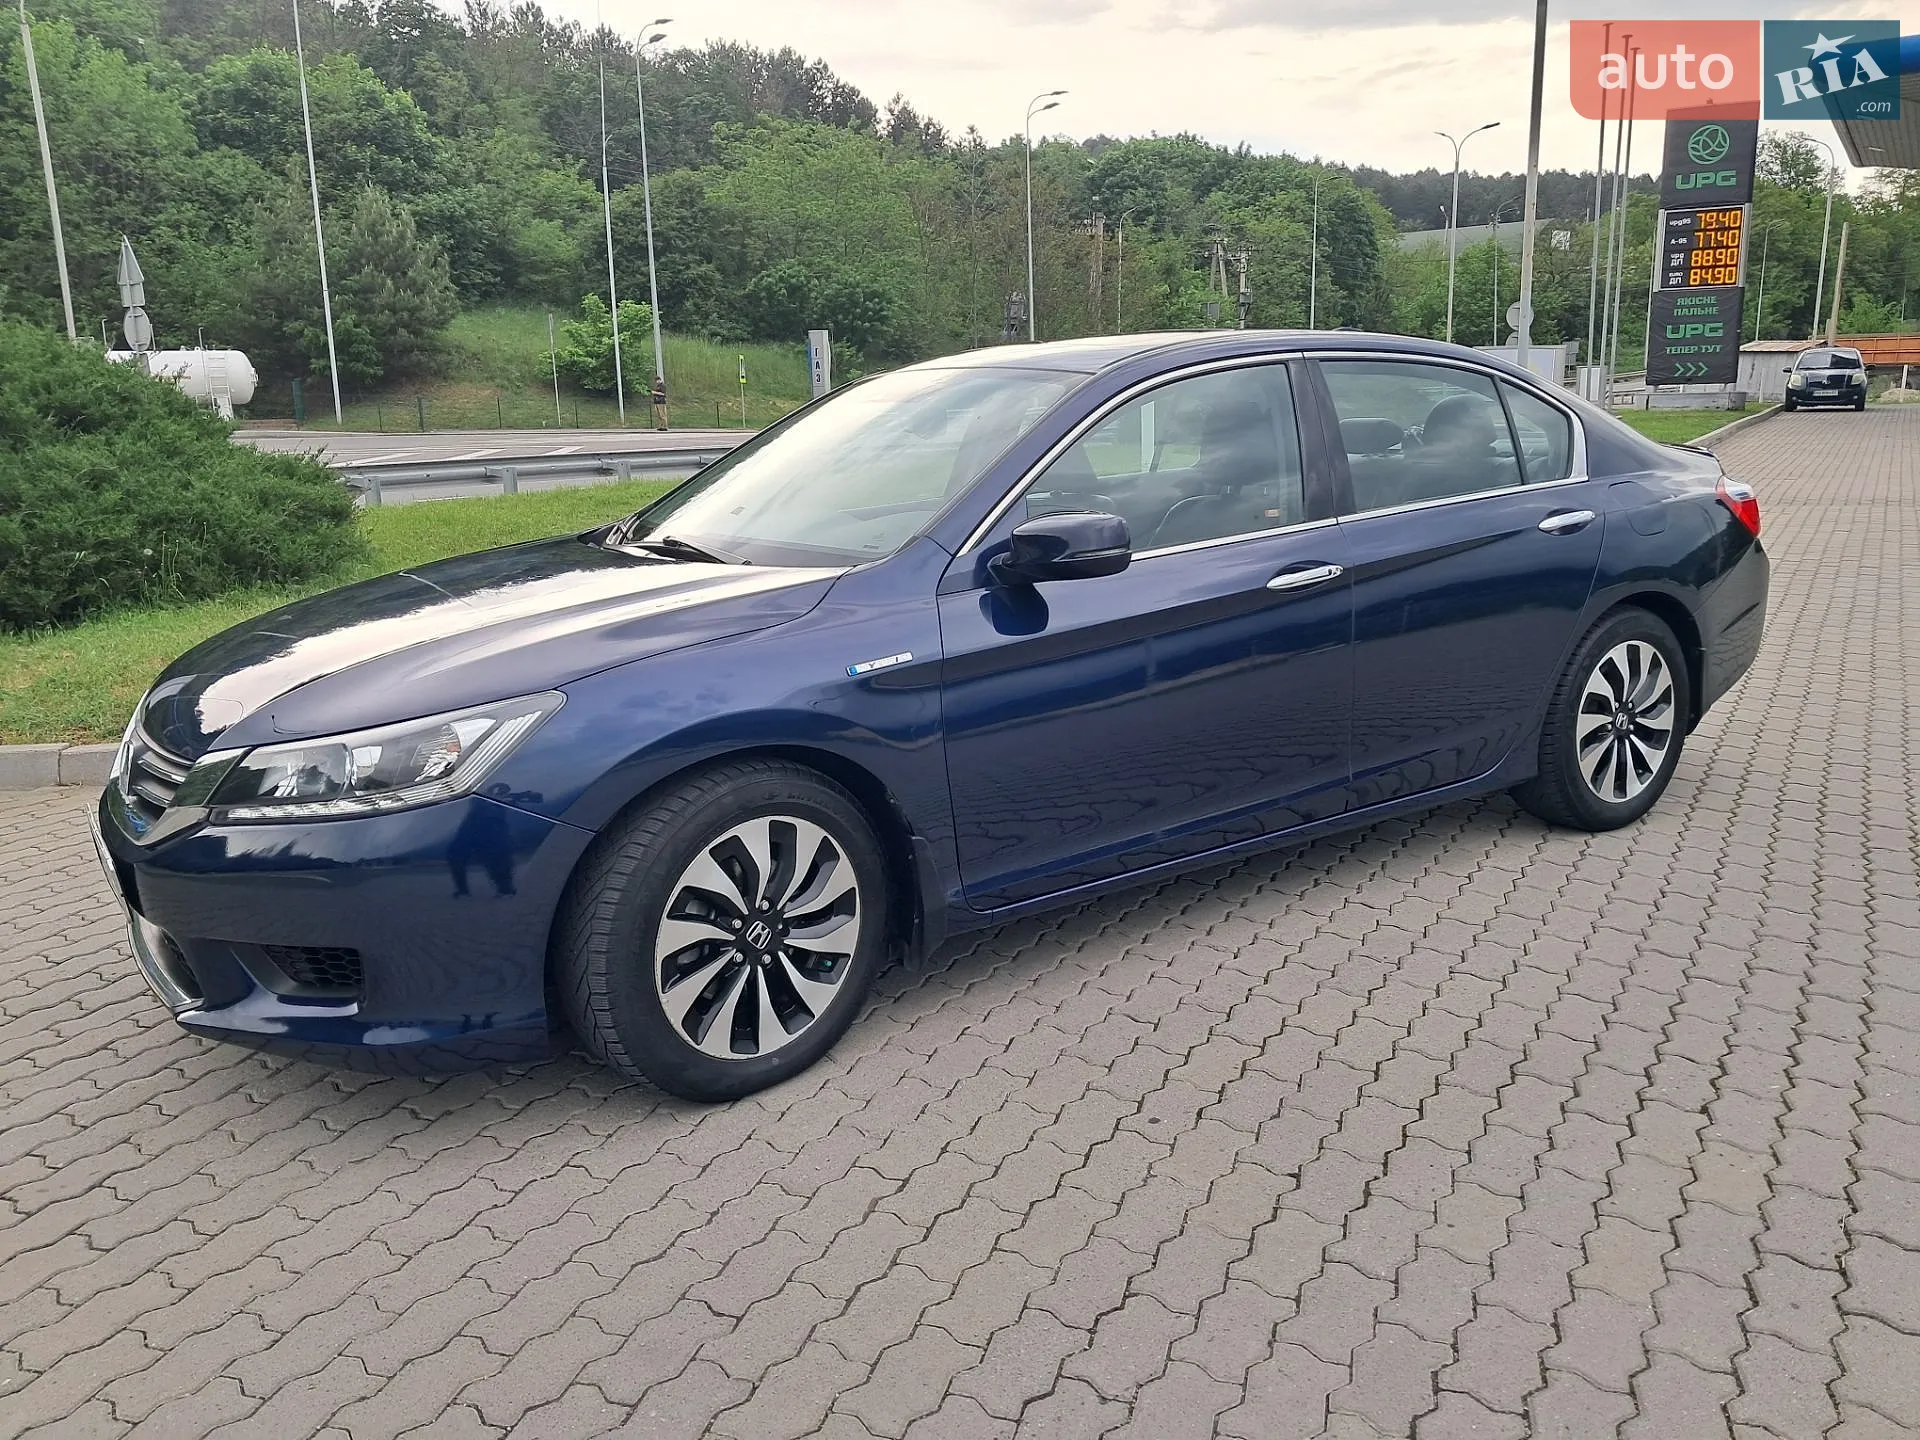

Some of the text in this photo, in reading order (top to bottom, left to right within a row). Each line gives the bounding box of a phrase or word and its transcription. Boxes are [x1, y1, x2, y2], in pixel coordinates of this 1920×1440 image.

[1675, 170, 1737, 190] UPG
[1696, 210, 1742, 229] 79.40
[1694, 229, 1740, 248] 77.40
[1690, 248, 1738, 267] 88.90
[1689, 266, 1737, 285] 84.90
[1676, 295, 1718, 306] ЯКІСНЕ
[1673, 306, 1720, 316] ПАЛЬНЕ
[1666, 322, 1724, 339] UPG
[1665, 344, 1723, 355] ТЕПЕР ТУТ
